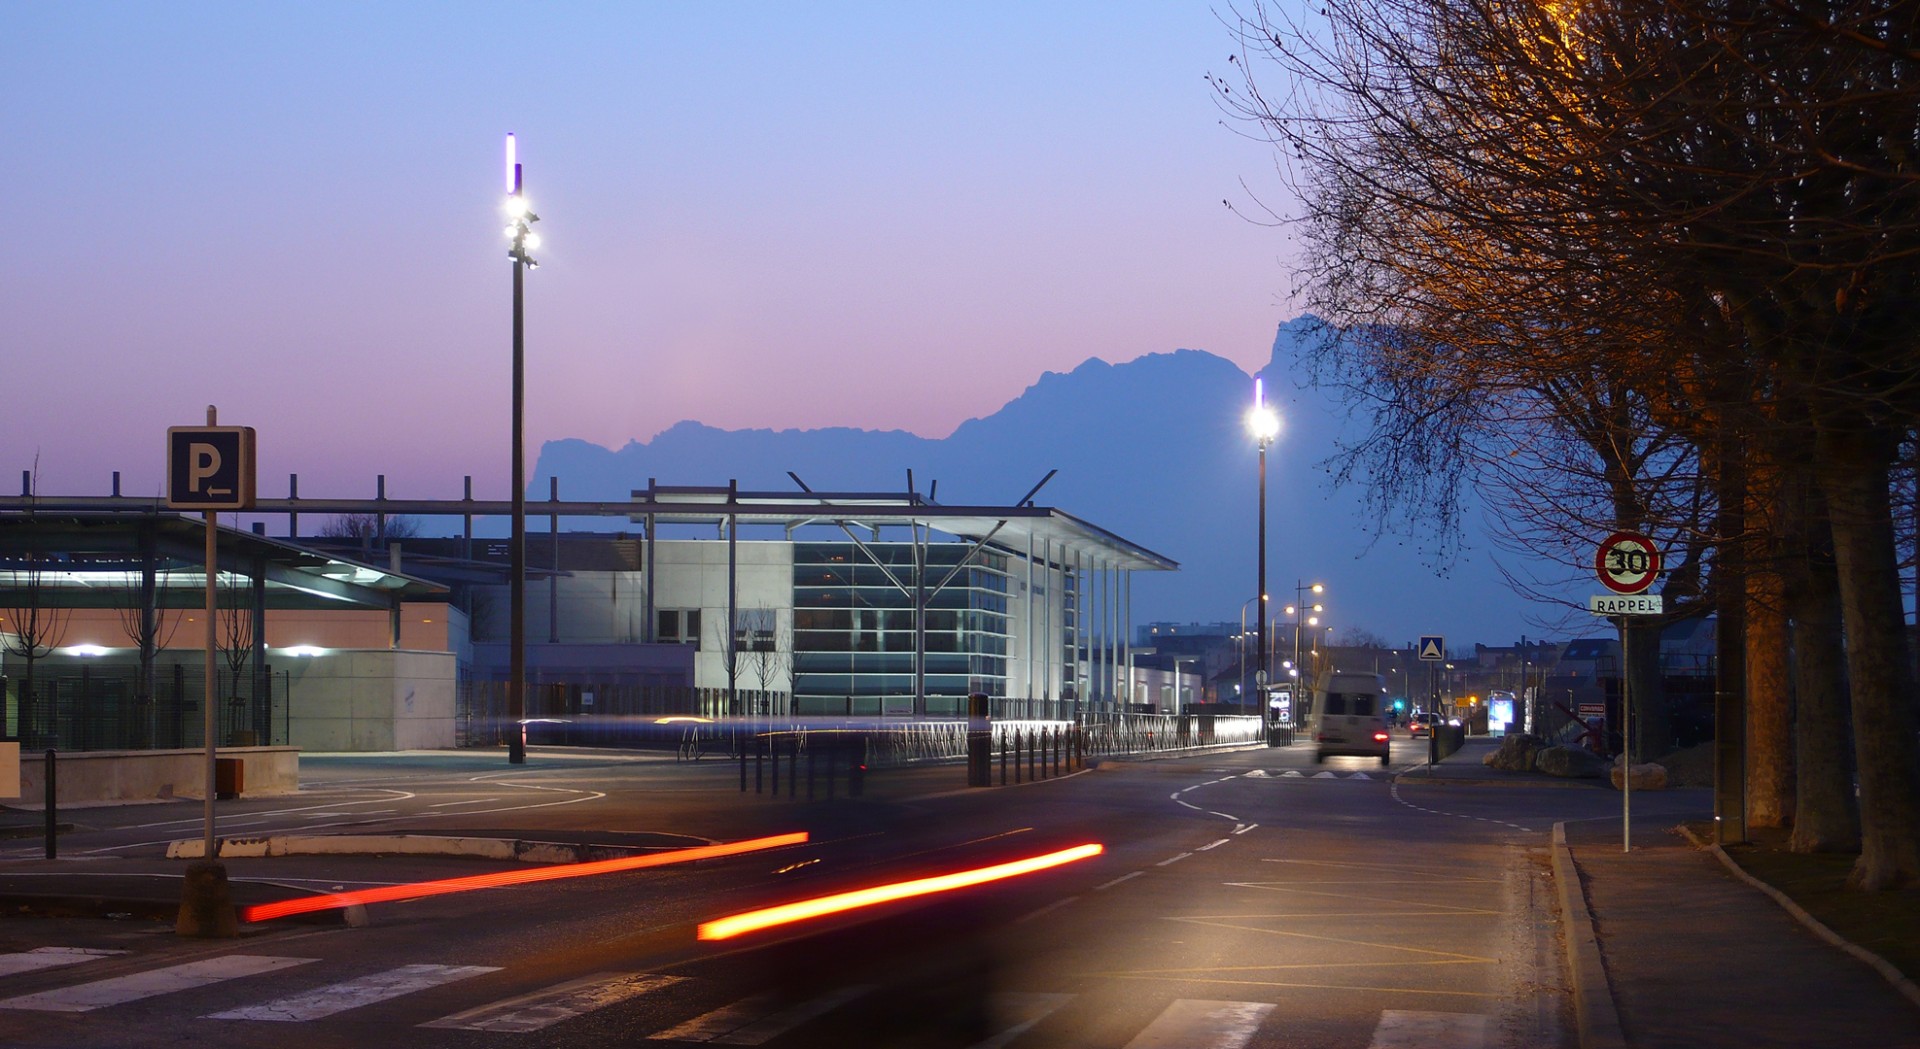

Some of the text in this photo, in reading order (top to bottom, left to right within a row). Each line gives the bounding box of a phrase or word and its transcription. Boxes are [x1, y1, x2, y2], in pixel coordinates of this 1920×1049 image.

[189, 443, 222, 492] P
[1608, 549, 1647, 576] 30
[1597, 599, 1656, 612] RAPPEL
